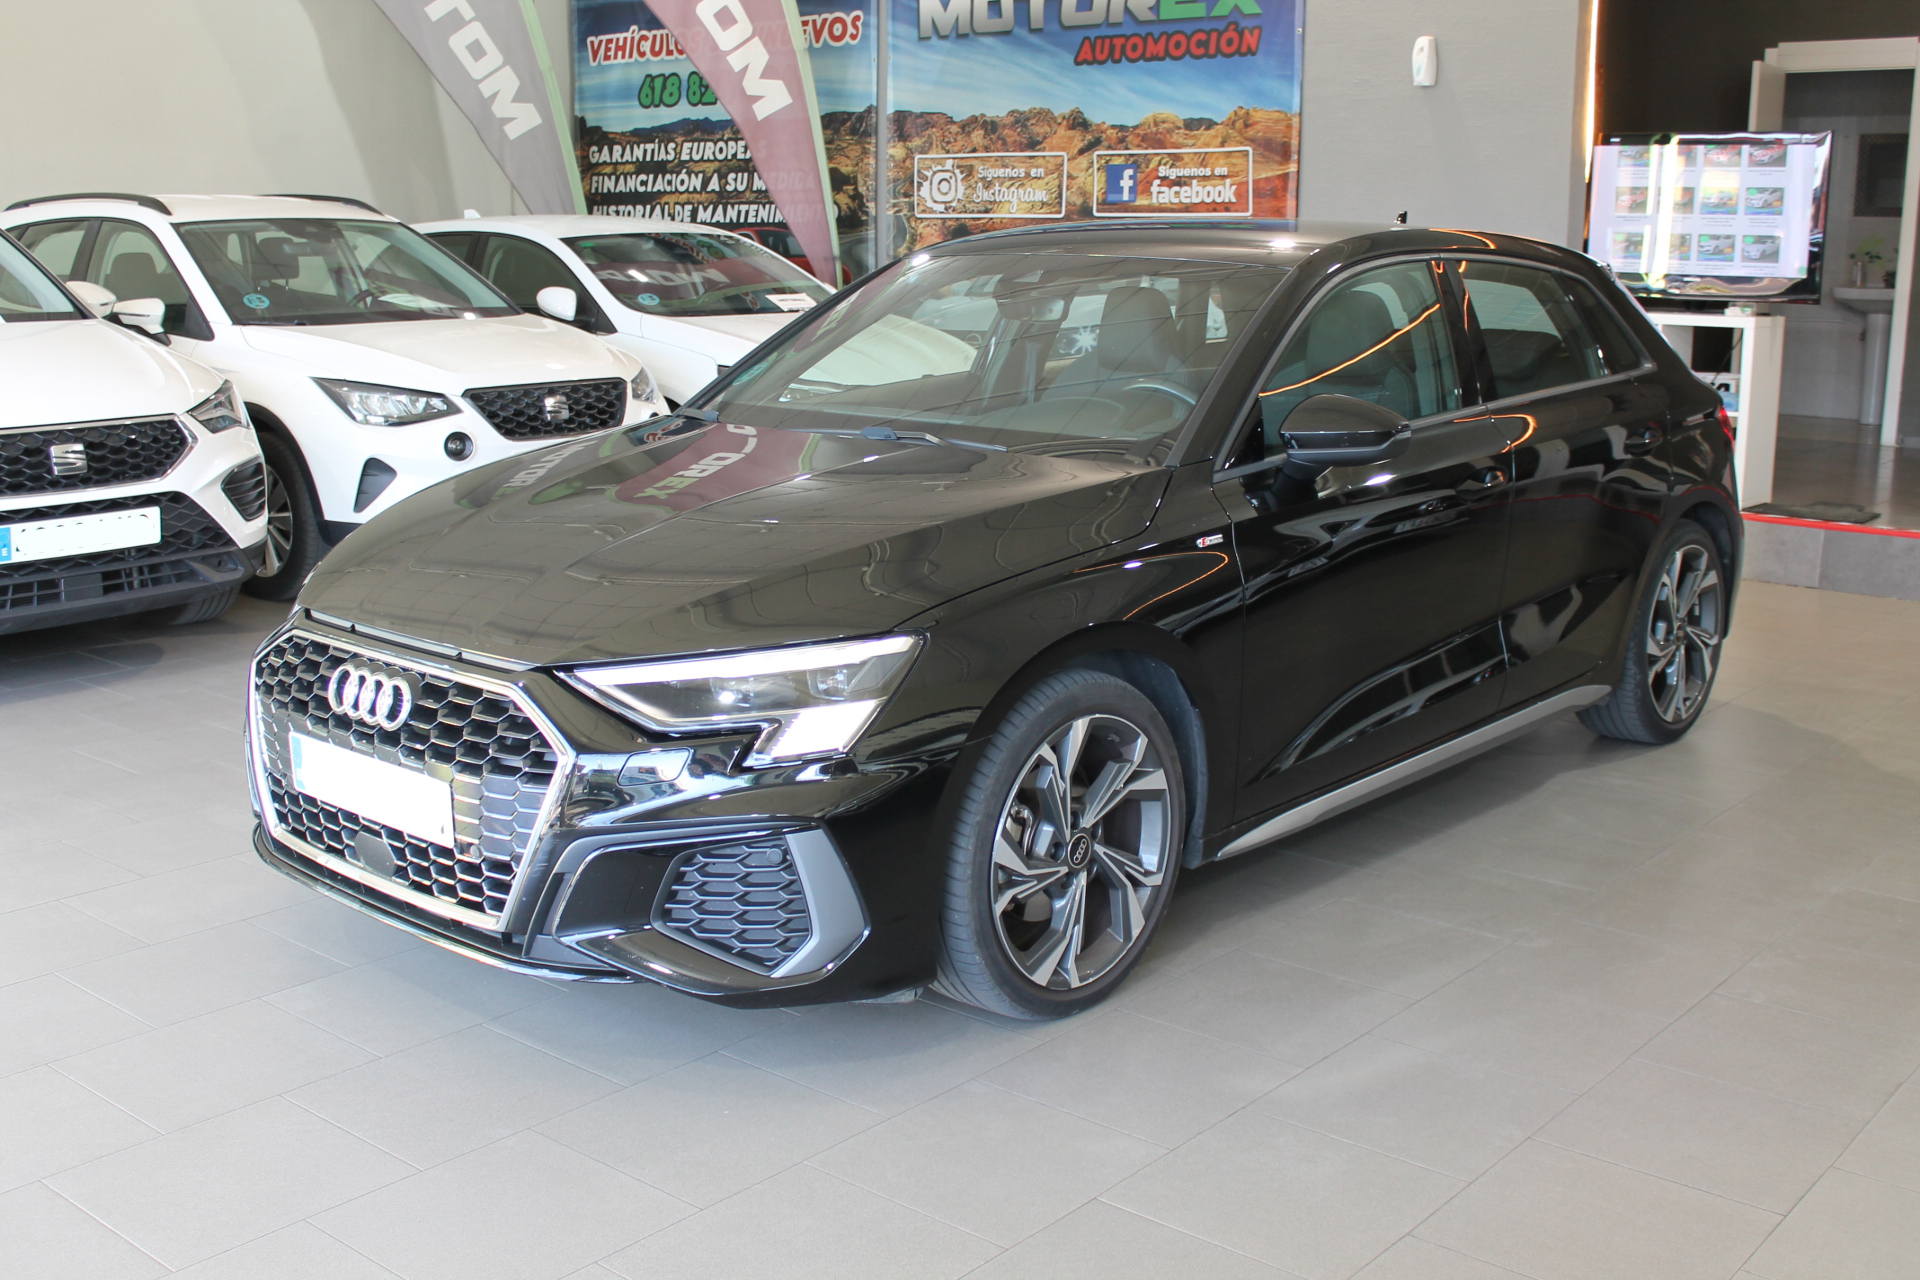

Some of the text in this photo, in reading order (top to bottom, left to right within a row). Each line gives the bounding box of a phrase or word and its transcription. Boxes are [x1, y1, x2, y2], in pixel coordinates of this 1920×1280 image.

[588, 26, 690, 65] VEHÍCULO
[1075, 23, 1262, 64] AUTOMOCIÓN
[639, 72, 681, 108] 618
[589, 138, 760, 163] GARANTÍAS EUROPEA
[591, 168, 703, 193] FINANCIACIÓN
[706, 172, 720, 192] A
[725, 171, 749, 192] SU
[1030, 167, 1044, 178] en
[1214, 166, 1228, 176] en
[973, 182, 1048, 213] Instagram
[1150, 178, 1238, 204] facebook
[592, 203, 672, 222] HISTORIAL
[674, 204, 693, 222] DE
